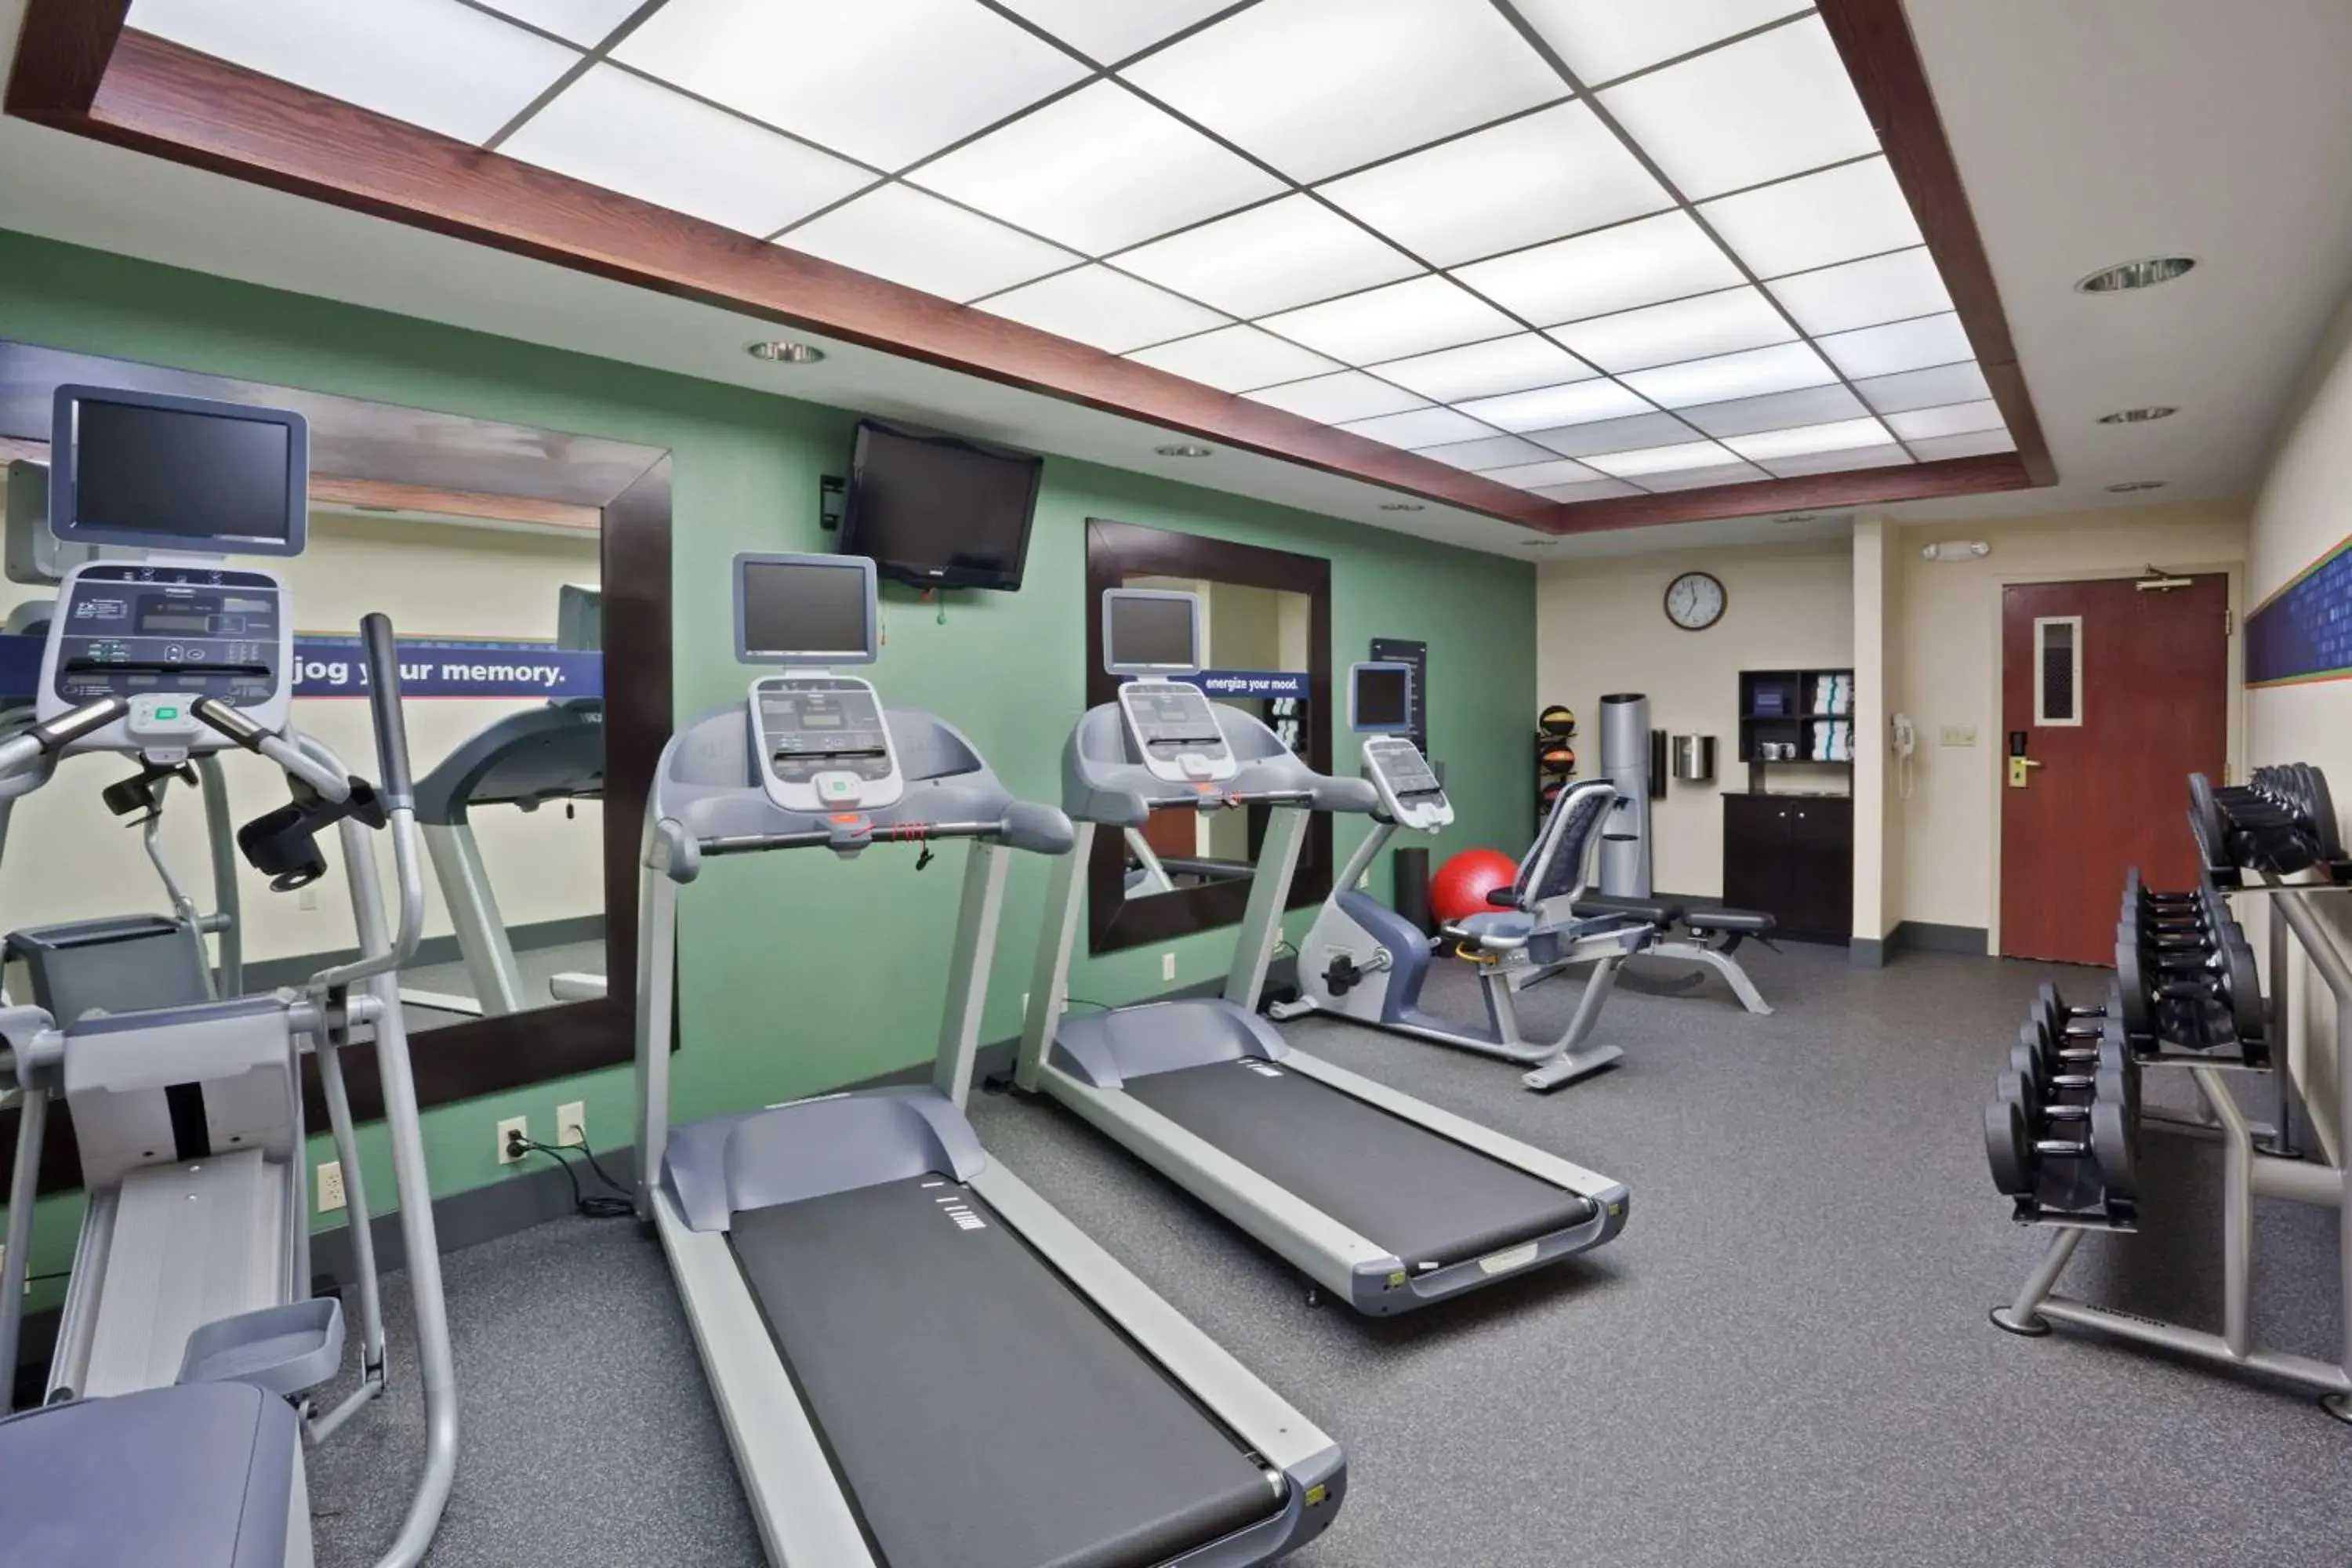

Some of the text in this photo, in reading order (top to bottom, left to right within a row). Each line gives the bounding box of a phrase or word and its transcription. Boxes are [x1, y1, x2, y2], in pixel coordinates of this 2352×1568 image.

[292, 656, 565, 687] jog yur memory.
[1206, 677, 1299, 692] energize your mood.
